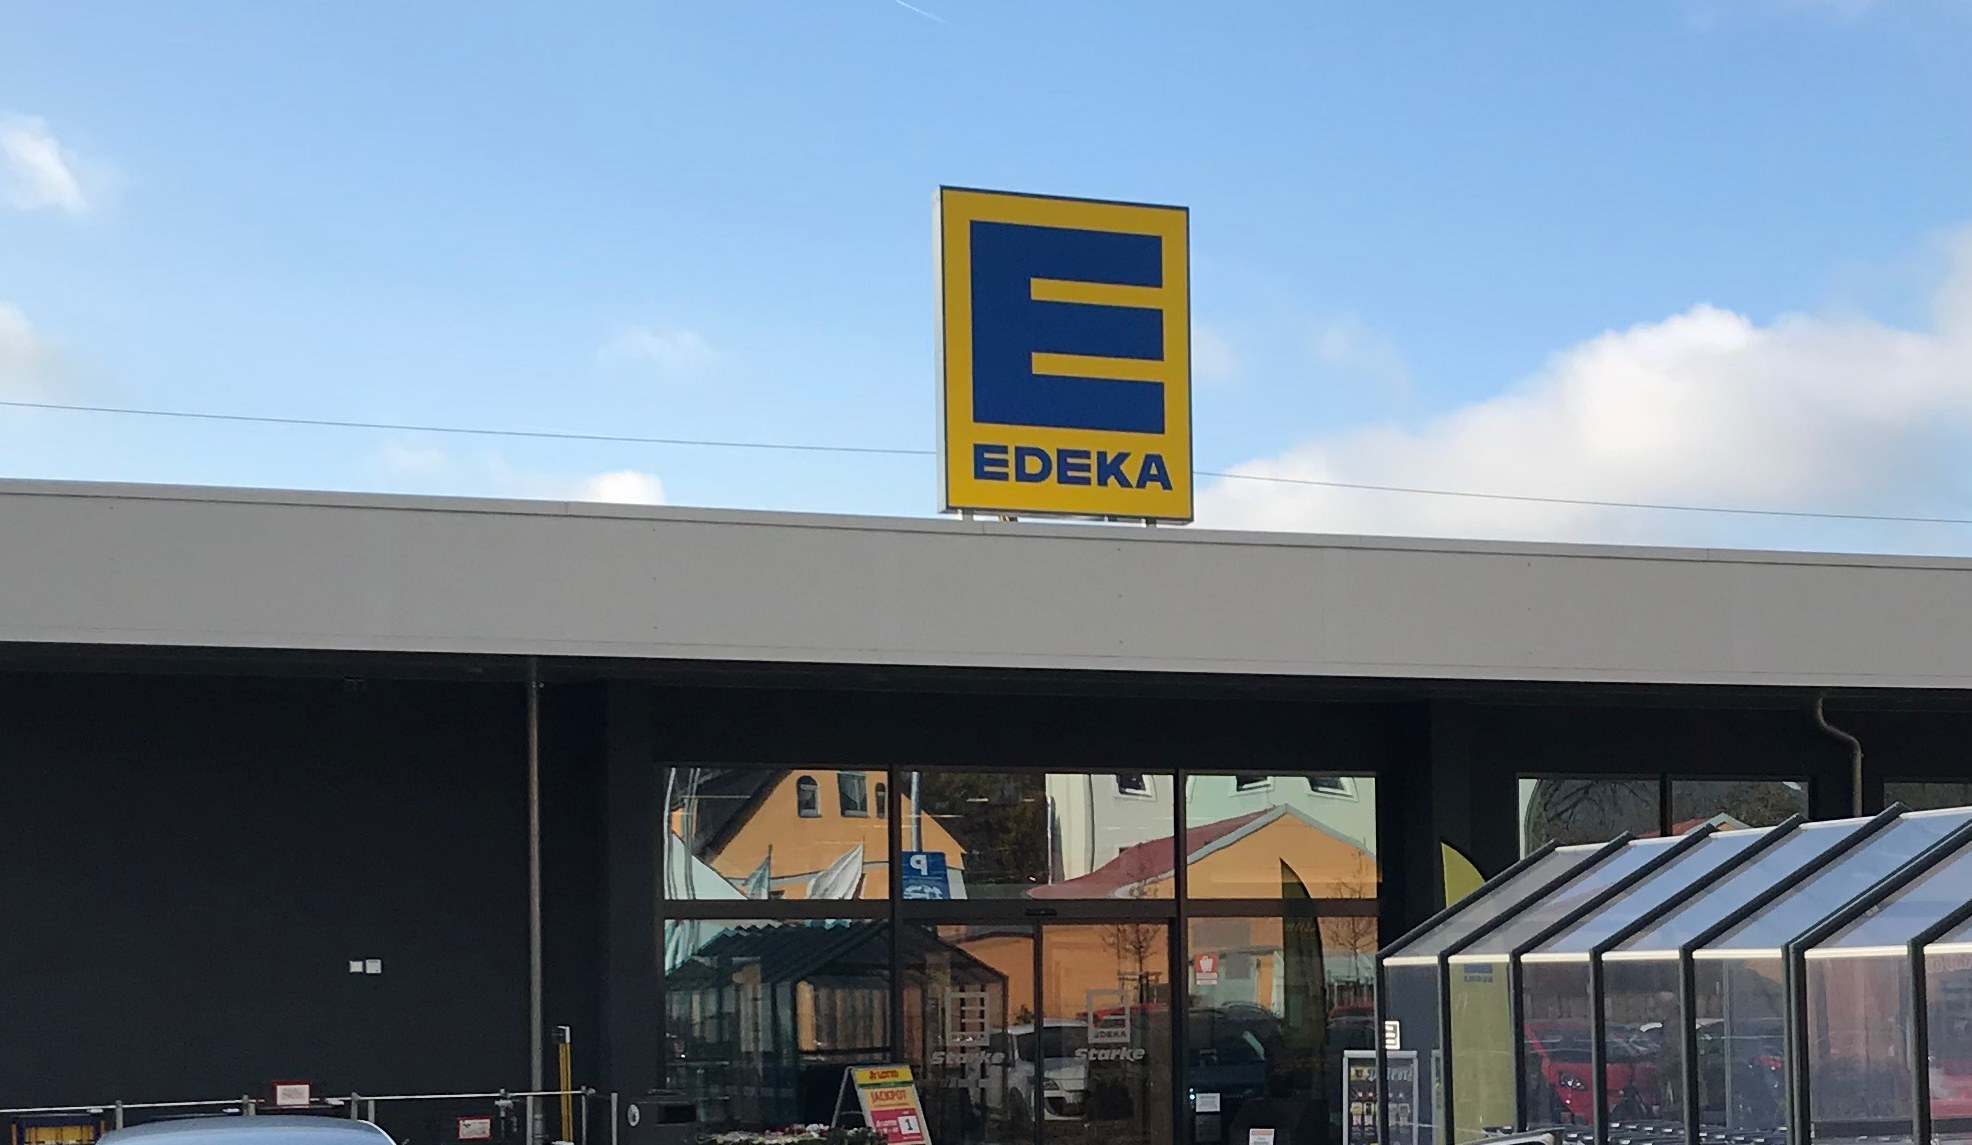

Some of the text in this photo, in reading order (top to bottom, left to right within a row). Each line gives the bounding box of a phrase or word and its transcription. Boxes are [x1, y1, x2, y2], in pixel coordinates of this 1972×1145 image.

[969, 219, 1165, 434] E
[972, 443, 1173, 491] EDEKA
[1074, 1046, 1146, 1062] Starke
